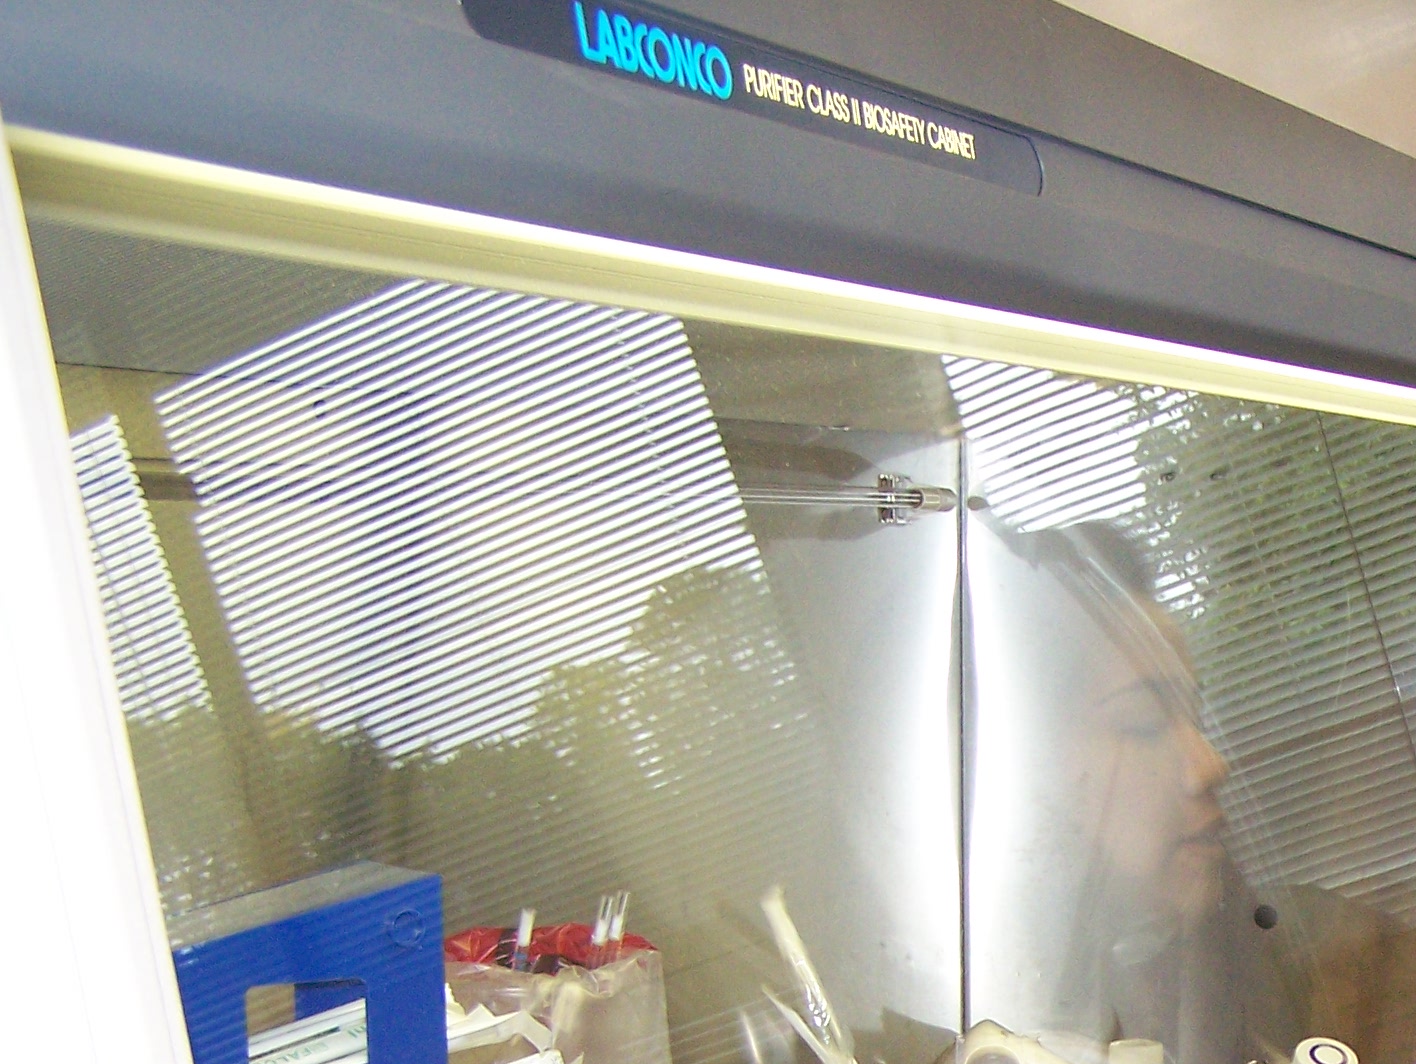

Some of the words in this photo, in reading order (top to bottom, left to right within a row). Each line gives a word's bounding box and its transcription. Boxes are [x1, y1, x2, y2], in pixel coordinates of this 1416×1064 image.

[574, 0, 734, 100] LABCONCO
[743, 63, 806, 110] PURIFIER
[806, 84, 851, 123] CLASS
[850, 97, 862, 127] II
[862, 100, 926, 145] BIOSAFETY
[927, 121, 977, 160] CABINET
